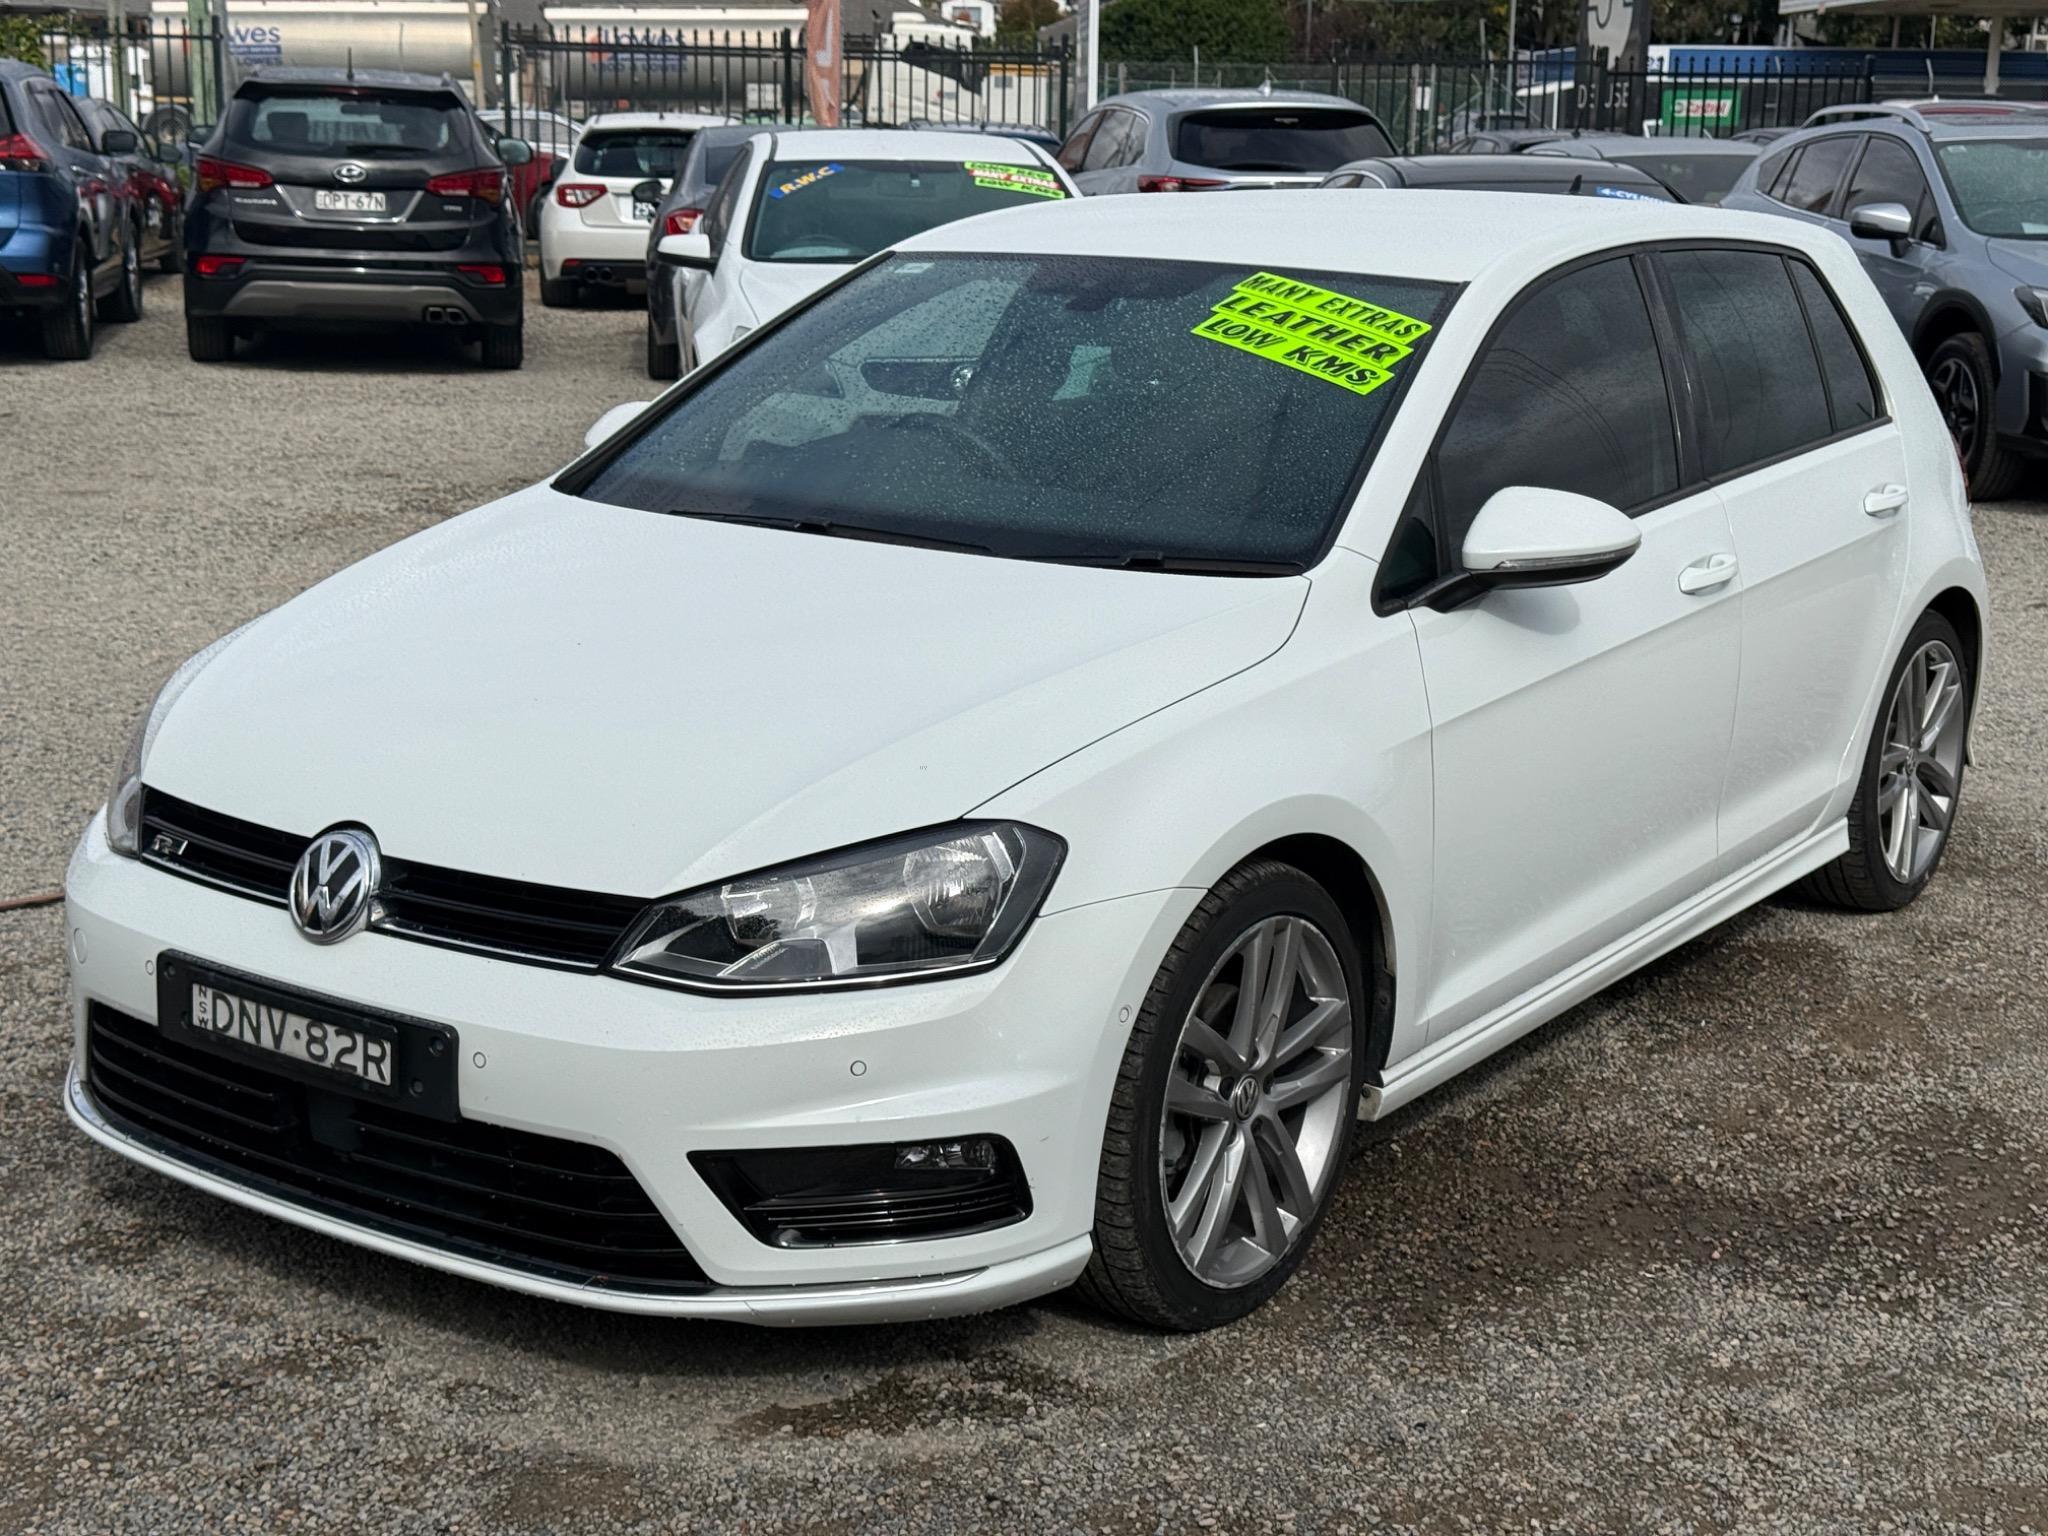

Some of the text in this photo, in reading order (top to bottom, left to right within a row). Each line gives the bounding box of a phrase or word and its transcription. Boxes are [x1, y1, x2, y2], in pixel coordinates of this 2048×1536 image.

[1217, 296, 1400, 362] LEATHER
[1240, 274, 1422, 337] MANY EXTRAS
[1202, 318, 1381, 385] LOW KMS
